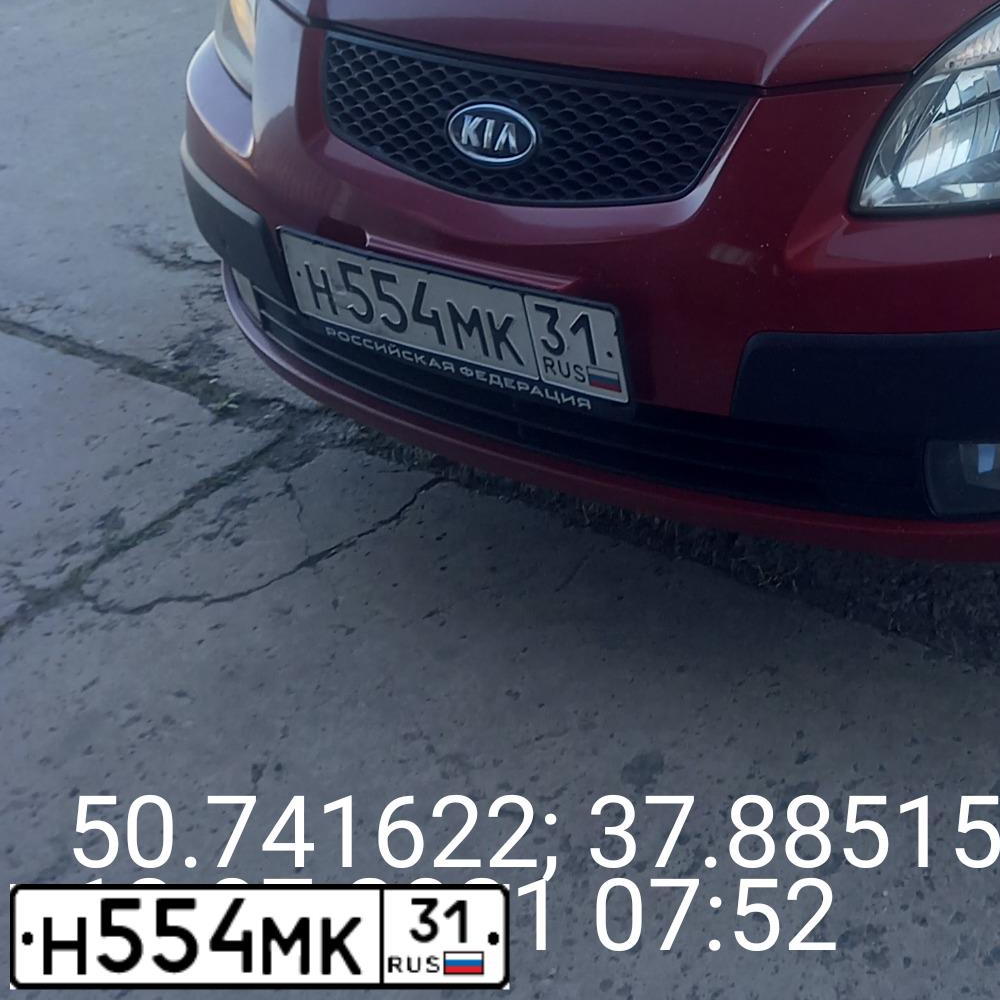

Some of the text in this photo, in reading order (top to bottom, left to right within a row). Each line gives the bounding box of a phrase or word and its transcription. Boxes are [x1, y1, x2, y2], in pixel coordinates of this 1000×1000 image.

[461, 114, 519, 154] KIA
[303, 260, 597, 368] Н554МК 31
[325, 326, 592, 410] РОССИЙСКАЯ ФЕДЕРАЦИЯ
[543, 356, 586, 383] RUS
